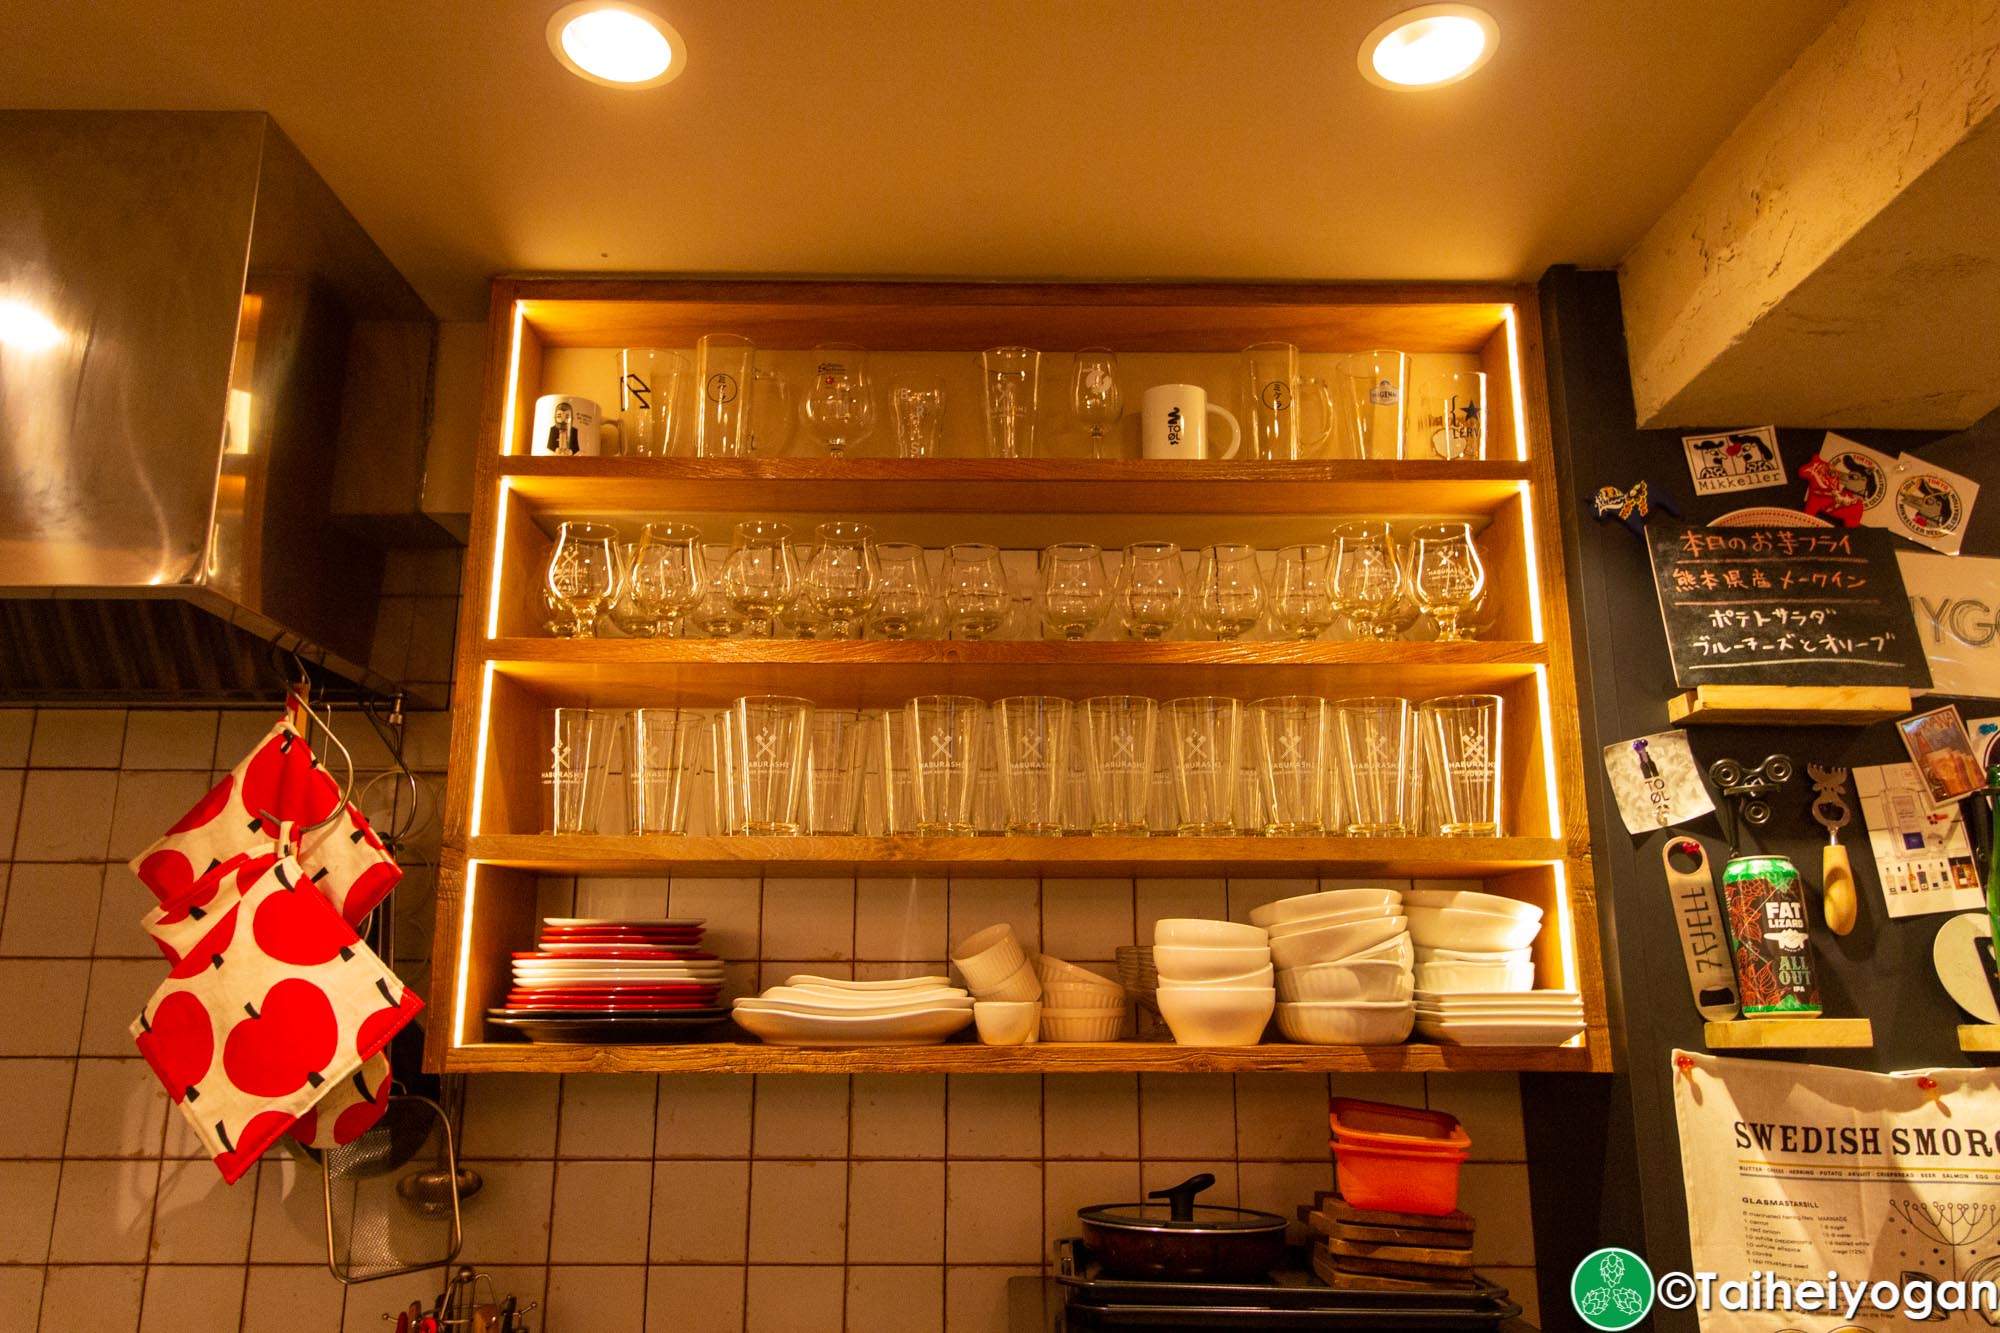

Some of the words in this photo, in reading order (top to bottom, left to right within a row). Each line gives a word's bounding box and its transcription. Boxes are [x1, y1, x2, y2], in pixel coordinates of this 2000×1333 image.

[1168, 425, 1181, 433] TO
[1698, 472, 1780, 491] Mikkeller
[1679, 530, 1852, 558] 本日のお芋フライ
[1708, 607, 1837, 629] ポテトサラダ
[1692, 631, 1896, 656] ブルーチーズとオリーブ
[1644, 778, 1665, 792] TO
[1650, 790, 1670, 804] ØL
[1765, 902, 1801, 920] FAT
[1768, 919, 1804, 929] LIZARD
[1778, 956, 1809, 971] ALL
[1778, 970, 1811, 985] OUT
[1793, 985, 1806, 993] IPA
[1734, 1121, 1882, 1155] SWEDISH
[1891, 1128, 2000, 1157] SMOR
